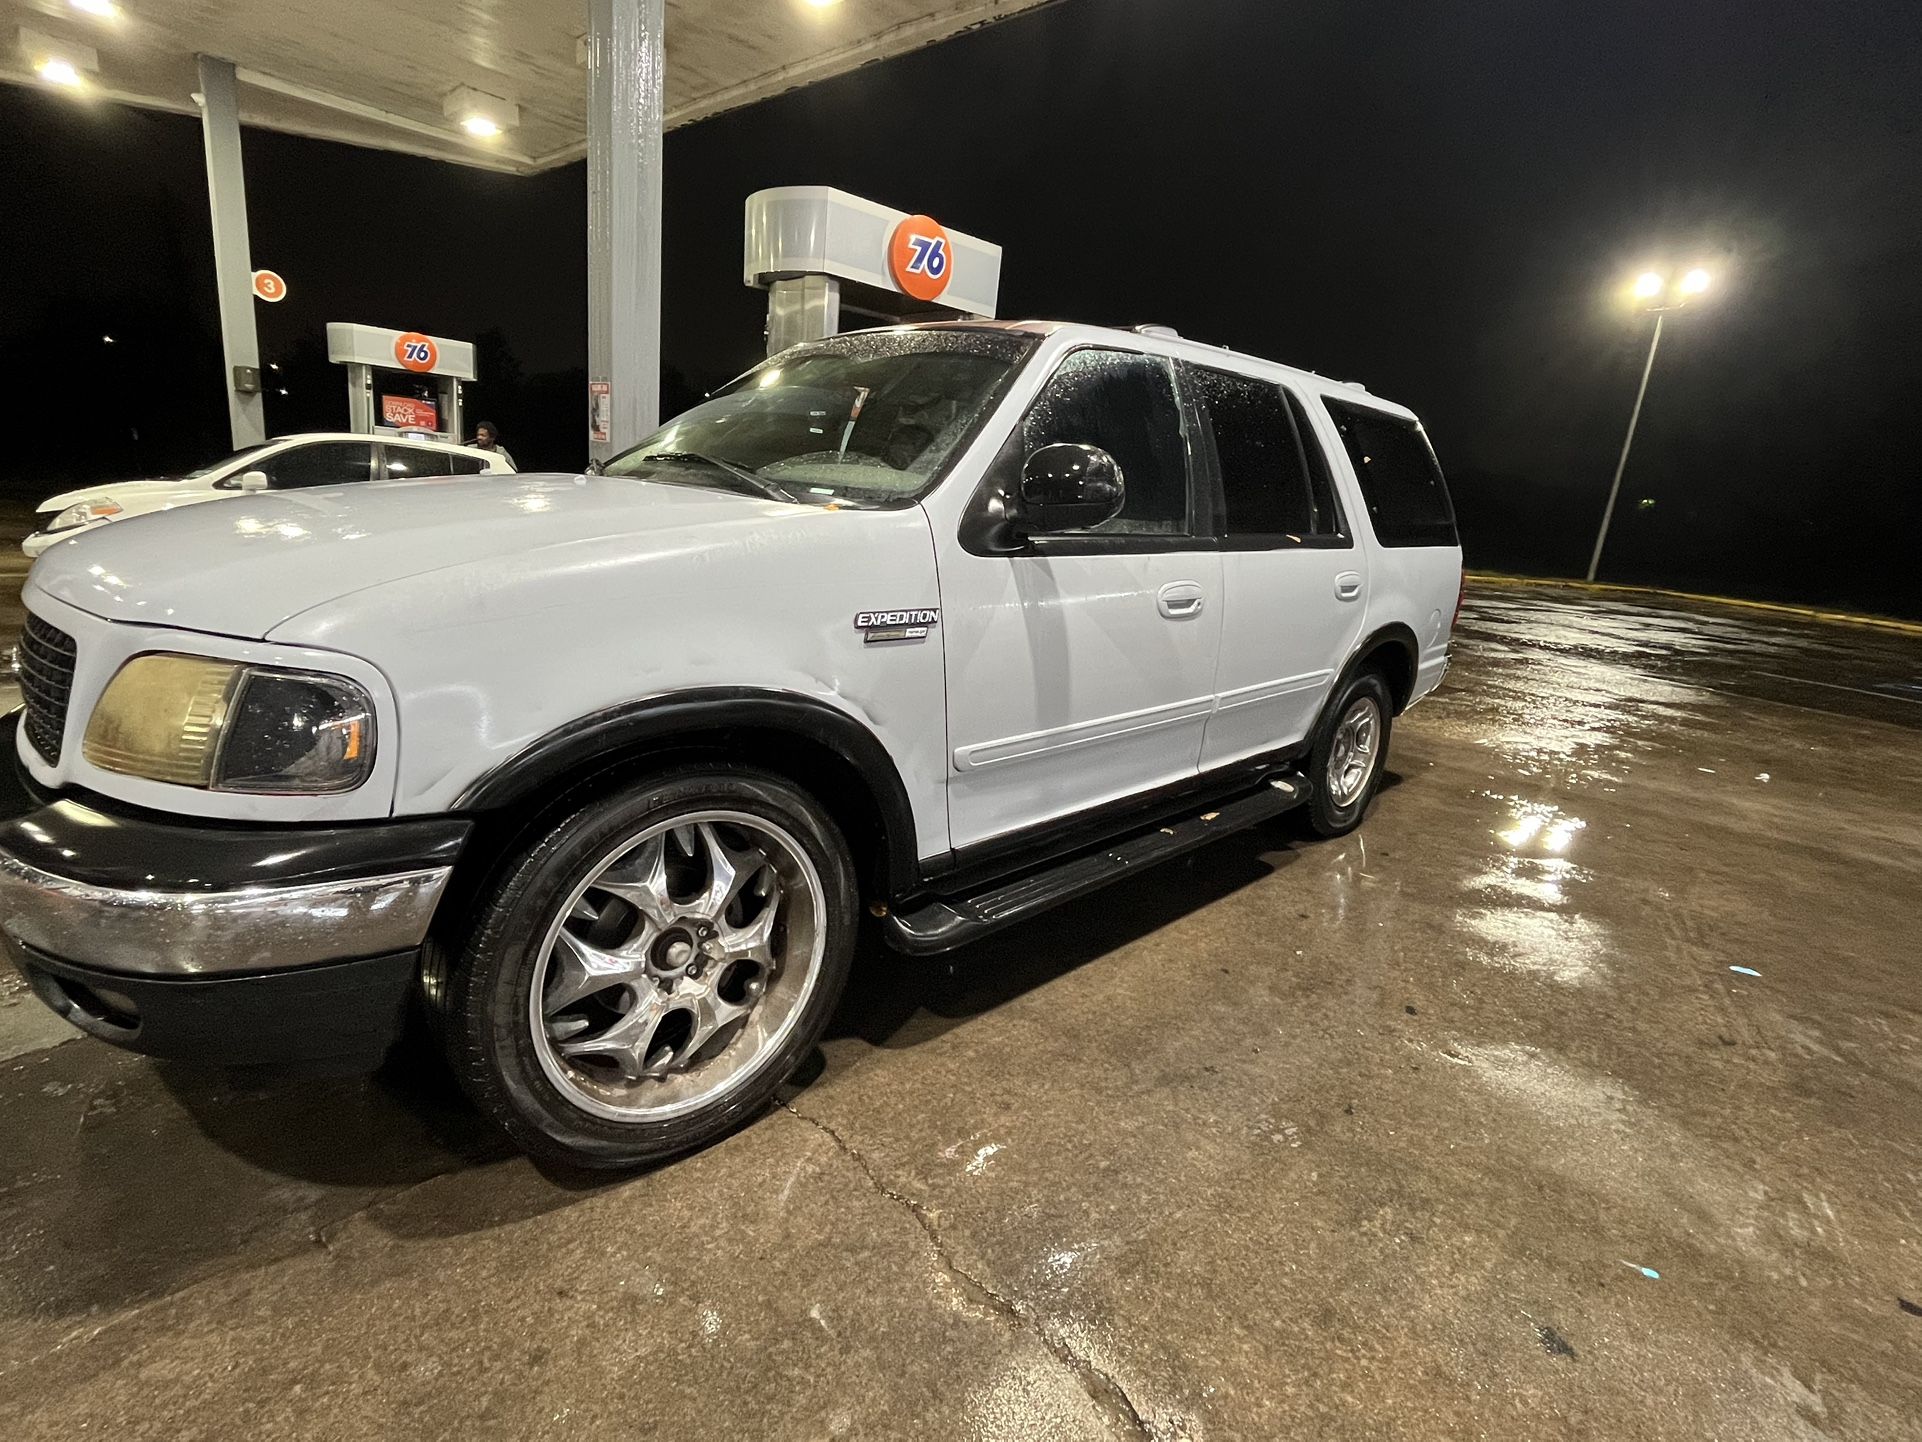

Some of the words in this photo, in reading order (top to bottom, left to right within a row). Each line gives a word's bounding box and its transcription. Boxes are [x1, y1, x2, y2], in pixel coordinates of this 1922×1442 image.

[906, 233, 946, 279] 76
[263, 278, 276, 293] 3
[404, 342, 430, 362] 76
[385, 405, 415, 415] STACK
[385, 412, 416, 424] SAVE
[857, 609, 939, 626] EXPEDITION
